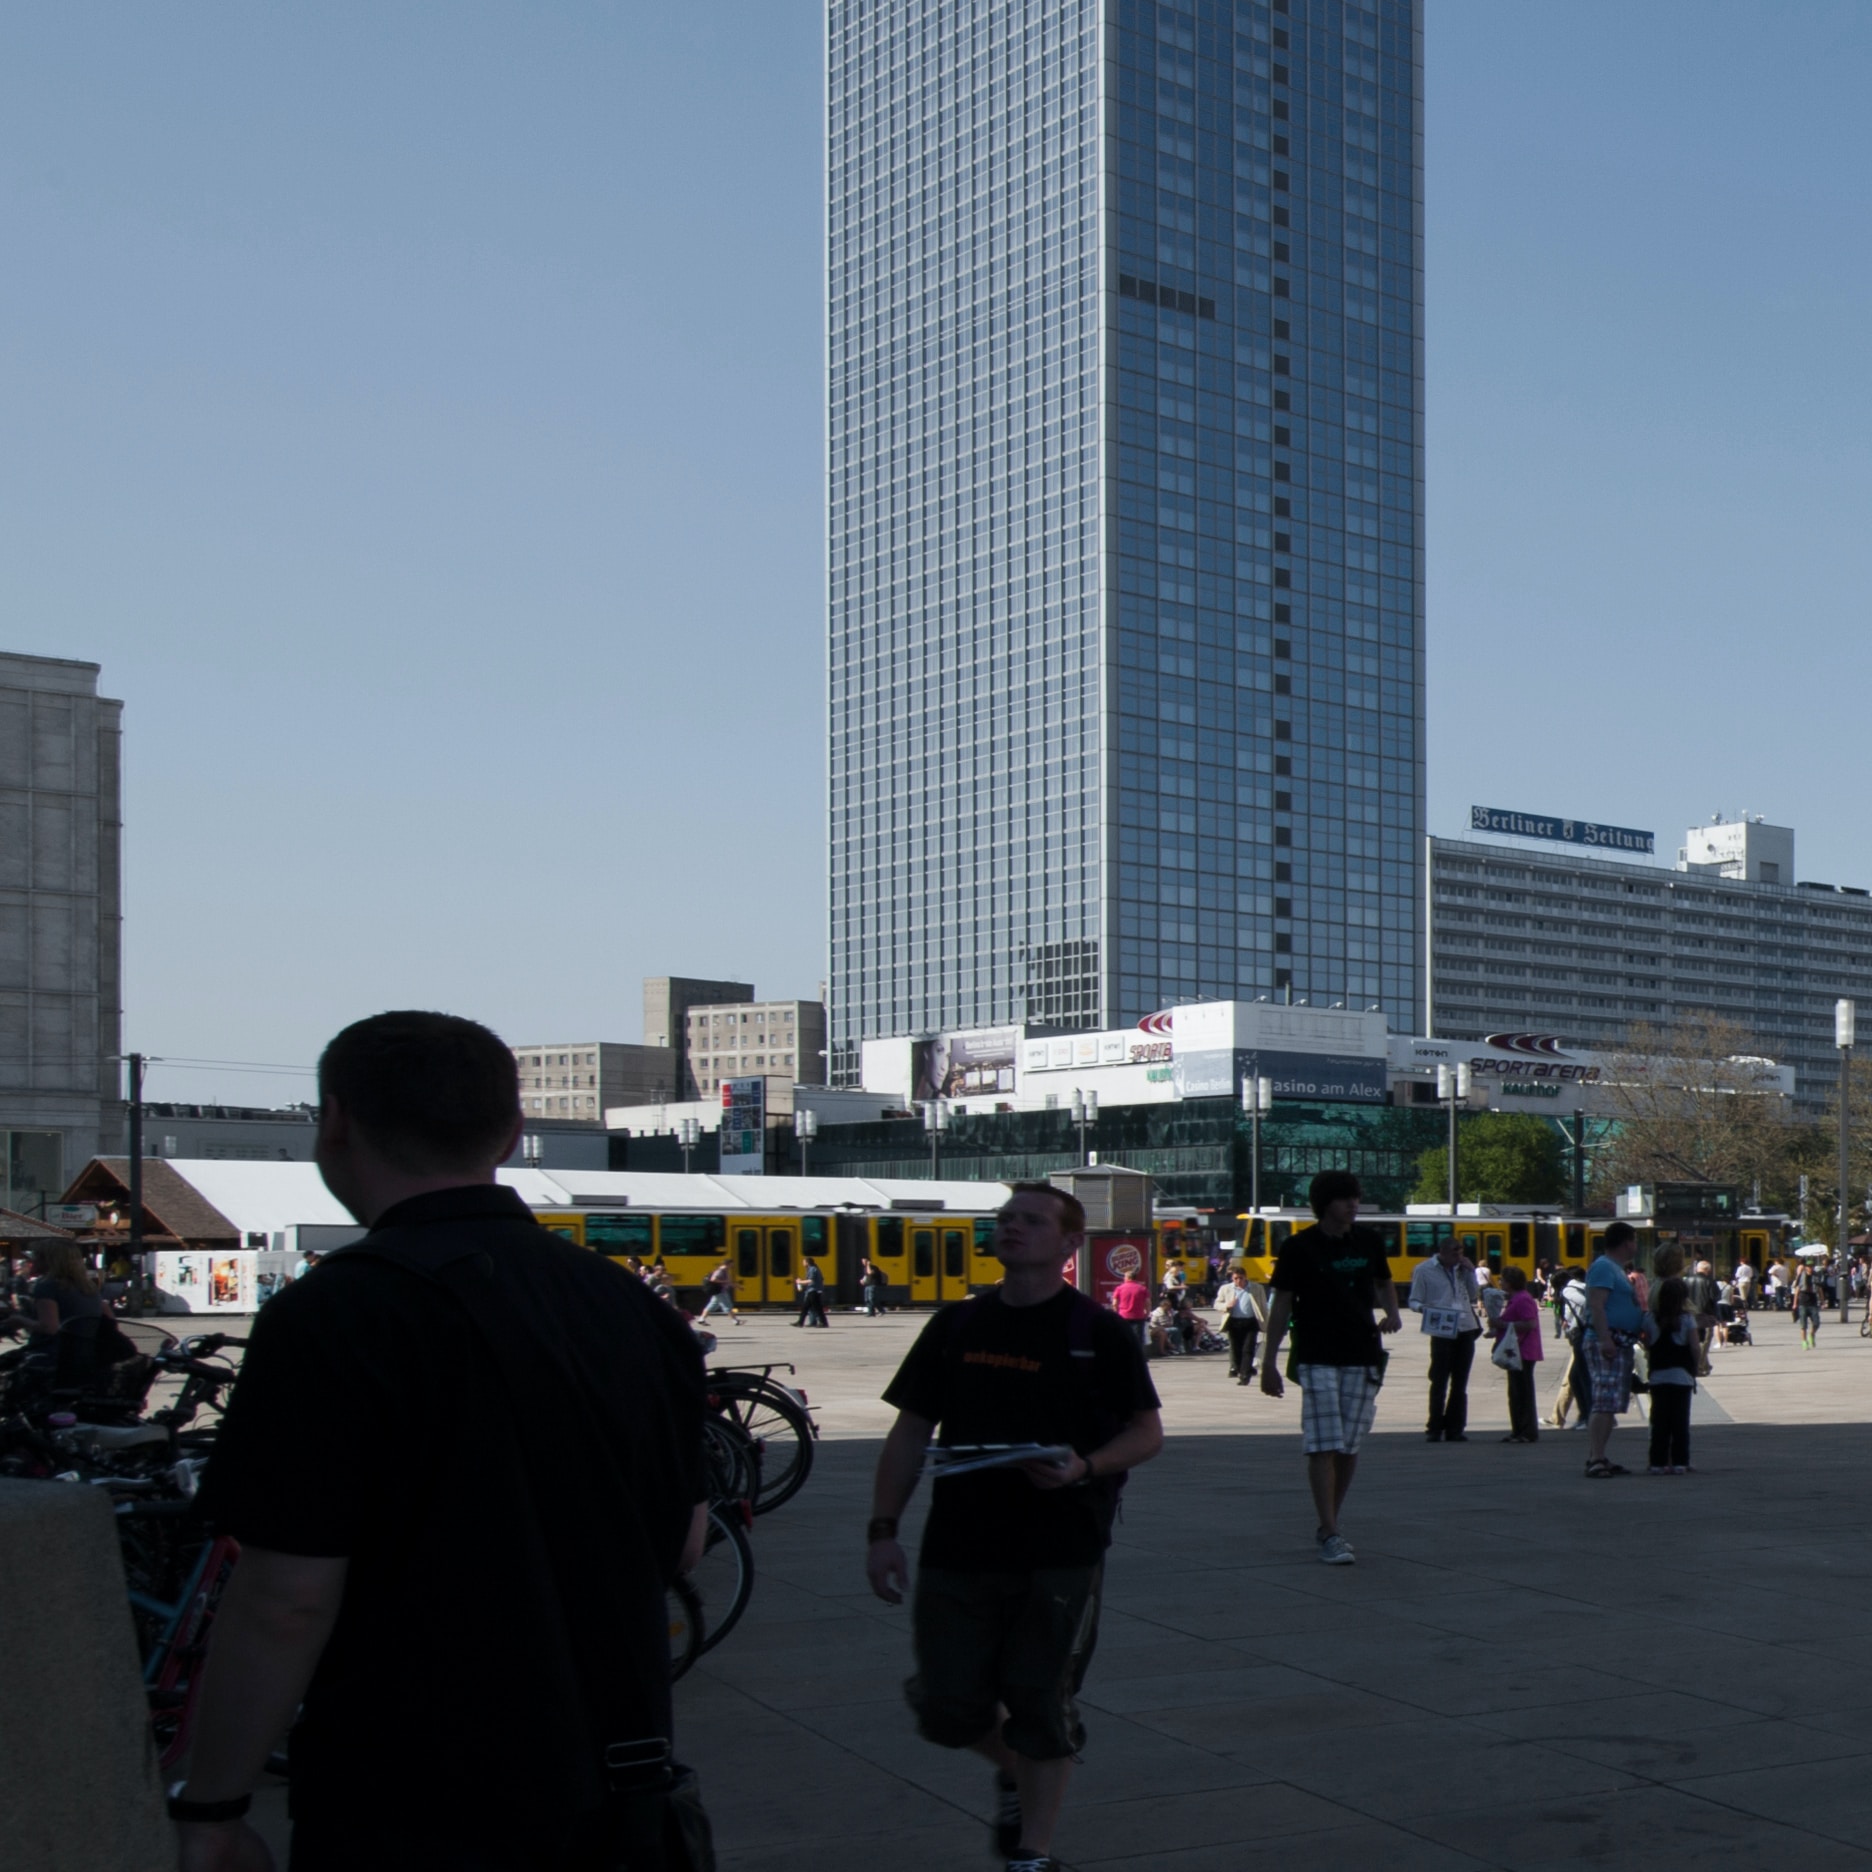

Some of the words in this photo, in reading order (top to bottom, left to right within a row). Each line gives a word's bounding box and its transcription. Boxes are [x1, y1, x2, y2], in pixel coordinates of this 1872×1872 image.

[1473, 807, 1554, 836] Berliner
[1584, 823, 1654, 854] Zeitung
[1273, 1079, 1317, 1094] asino
[1321, 1084, 1344, 1095] am
[1349, 1083, 1382, 1097] Alex
